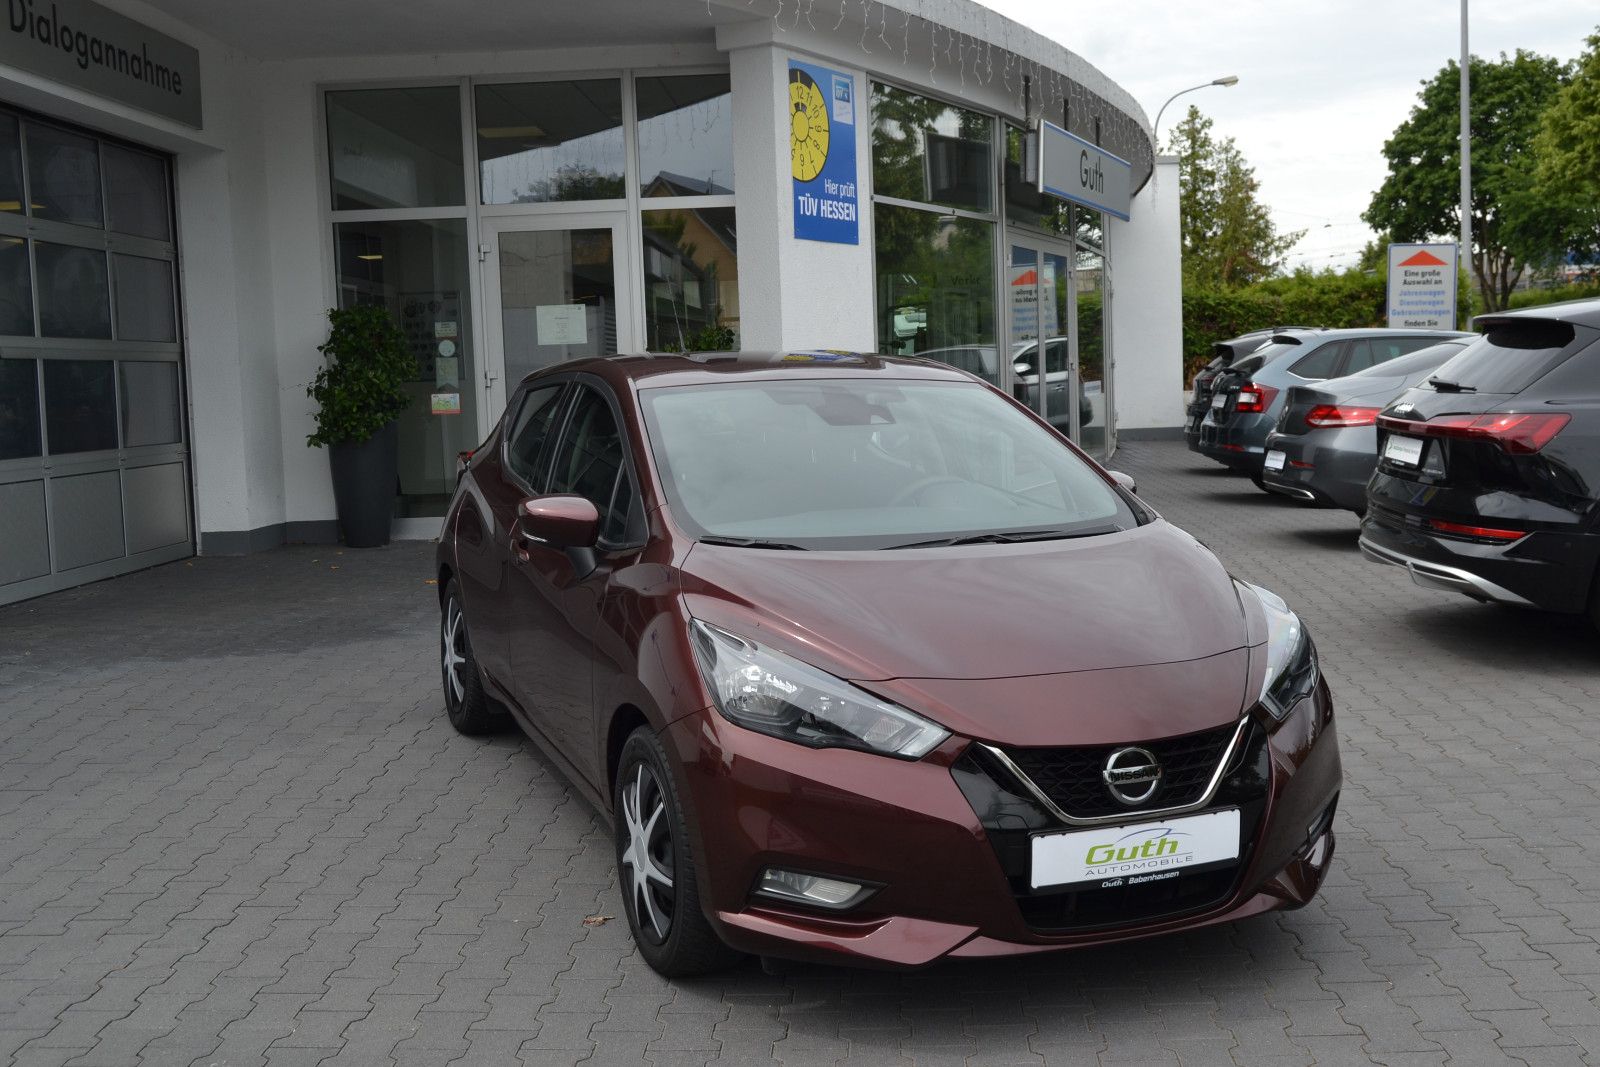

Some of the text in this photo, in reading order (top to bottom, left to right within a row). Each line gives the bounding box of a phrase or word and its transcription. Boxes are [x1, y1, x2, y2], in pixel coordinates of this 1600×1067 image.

[8, 0, 183, 95] Dialogannahme
[796, 85, 804, 100] 12
[812, 104, 820, 119] 10
[812, 139, 820, 150] 8
[1079, 149, 1104, 194] Guth
[824, 178, 856, 199] Hier prüft
[798, 193, 856, 222] TÜV HESSEN
[1421, 269, 1441, 278] große
[1427, 319, 1438, 327] Sie
[1108, 765, 1159, 782] NISSAN
[1085, 837, 1179, 866] Guth
[1084, 855, 1194, 877] AUTOMOBILE
[1101, 871, 1180, 888] Guth Babenhausen
